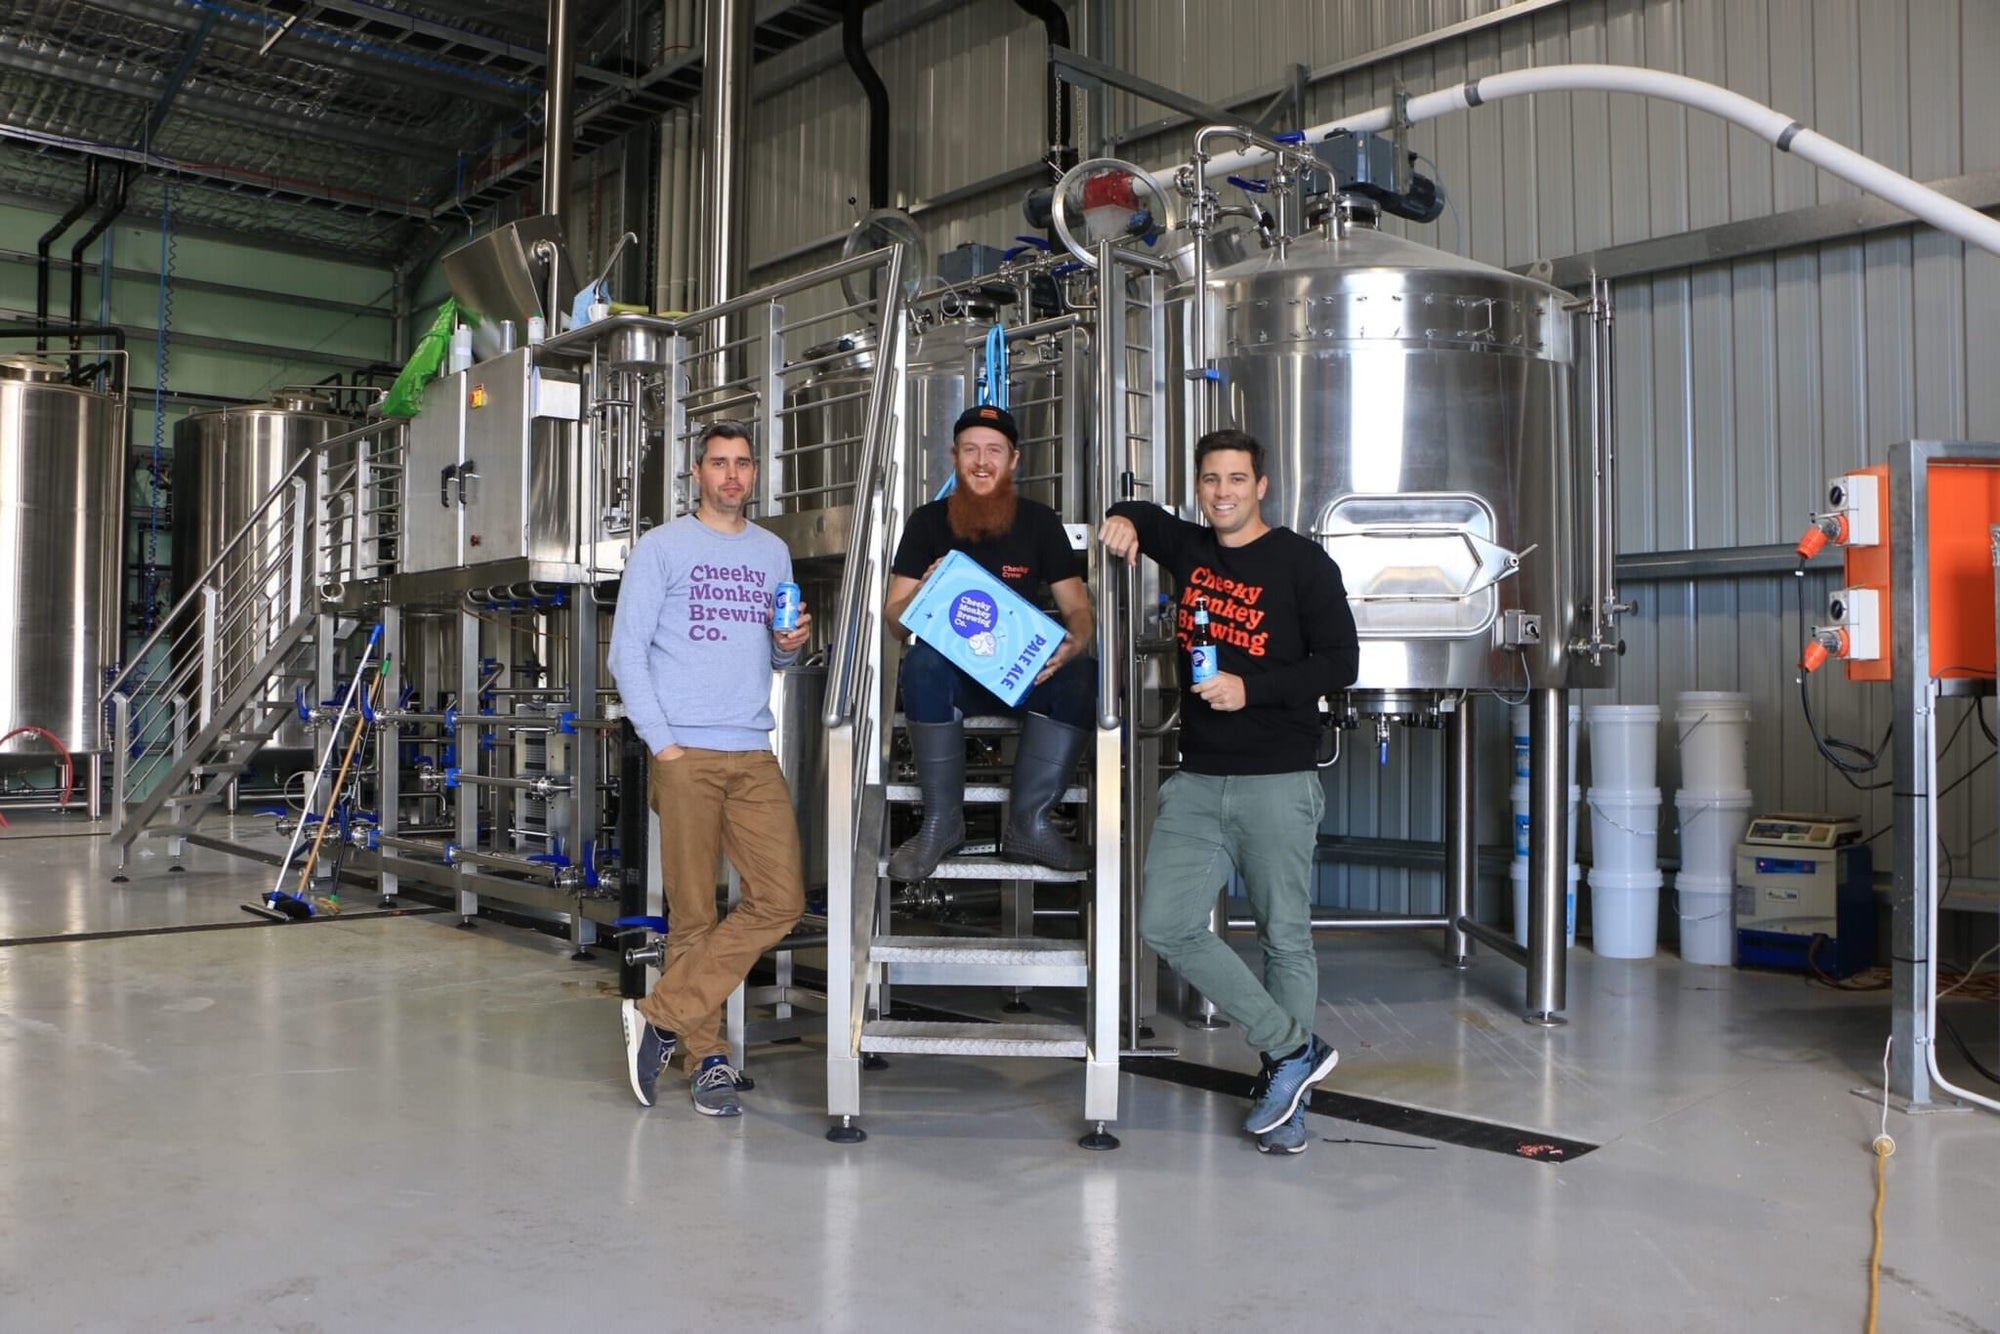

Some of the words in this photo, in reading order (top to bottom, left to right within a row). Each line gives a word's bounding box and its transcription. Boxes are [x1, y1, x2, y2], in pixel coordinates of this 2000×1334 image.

[690, 565, 766, 588] Cheeky
[1190, 566, 1264, 605] Cheeky
[689, 583, 773, 609] Monkey
[961, 596, 992, 612] Cheeky
[954, 618, 967, 628] Co.
[956, 610, 992, 628] Brewing
[959, 603, 992, 620] Monkey
[688, 624, 727, 641] Co.
[1179, 609, 1269, 656] Brwing
[1018, 634, 1047, 667] PALE
[1001, 663, 1024, 690] ALE
